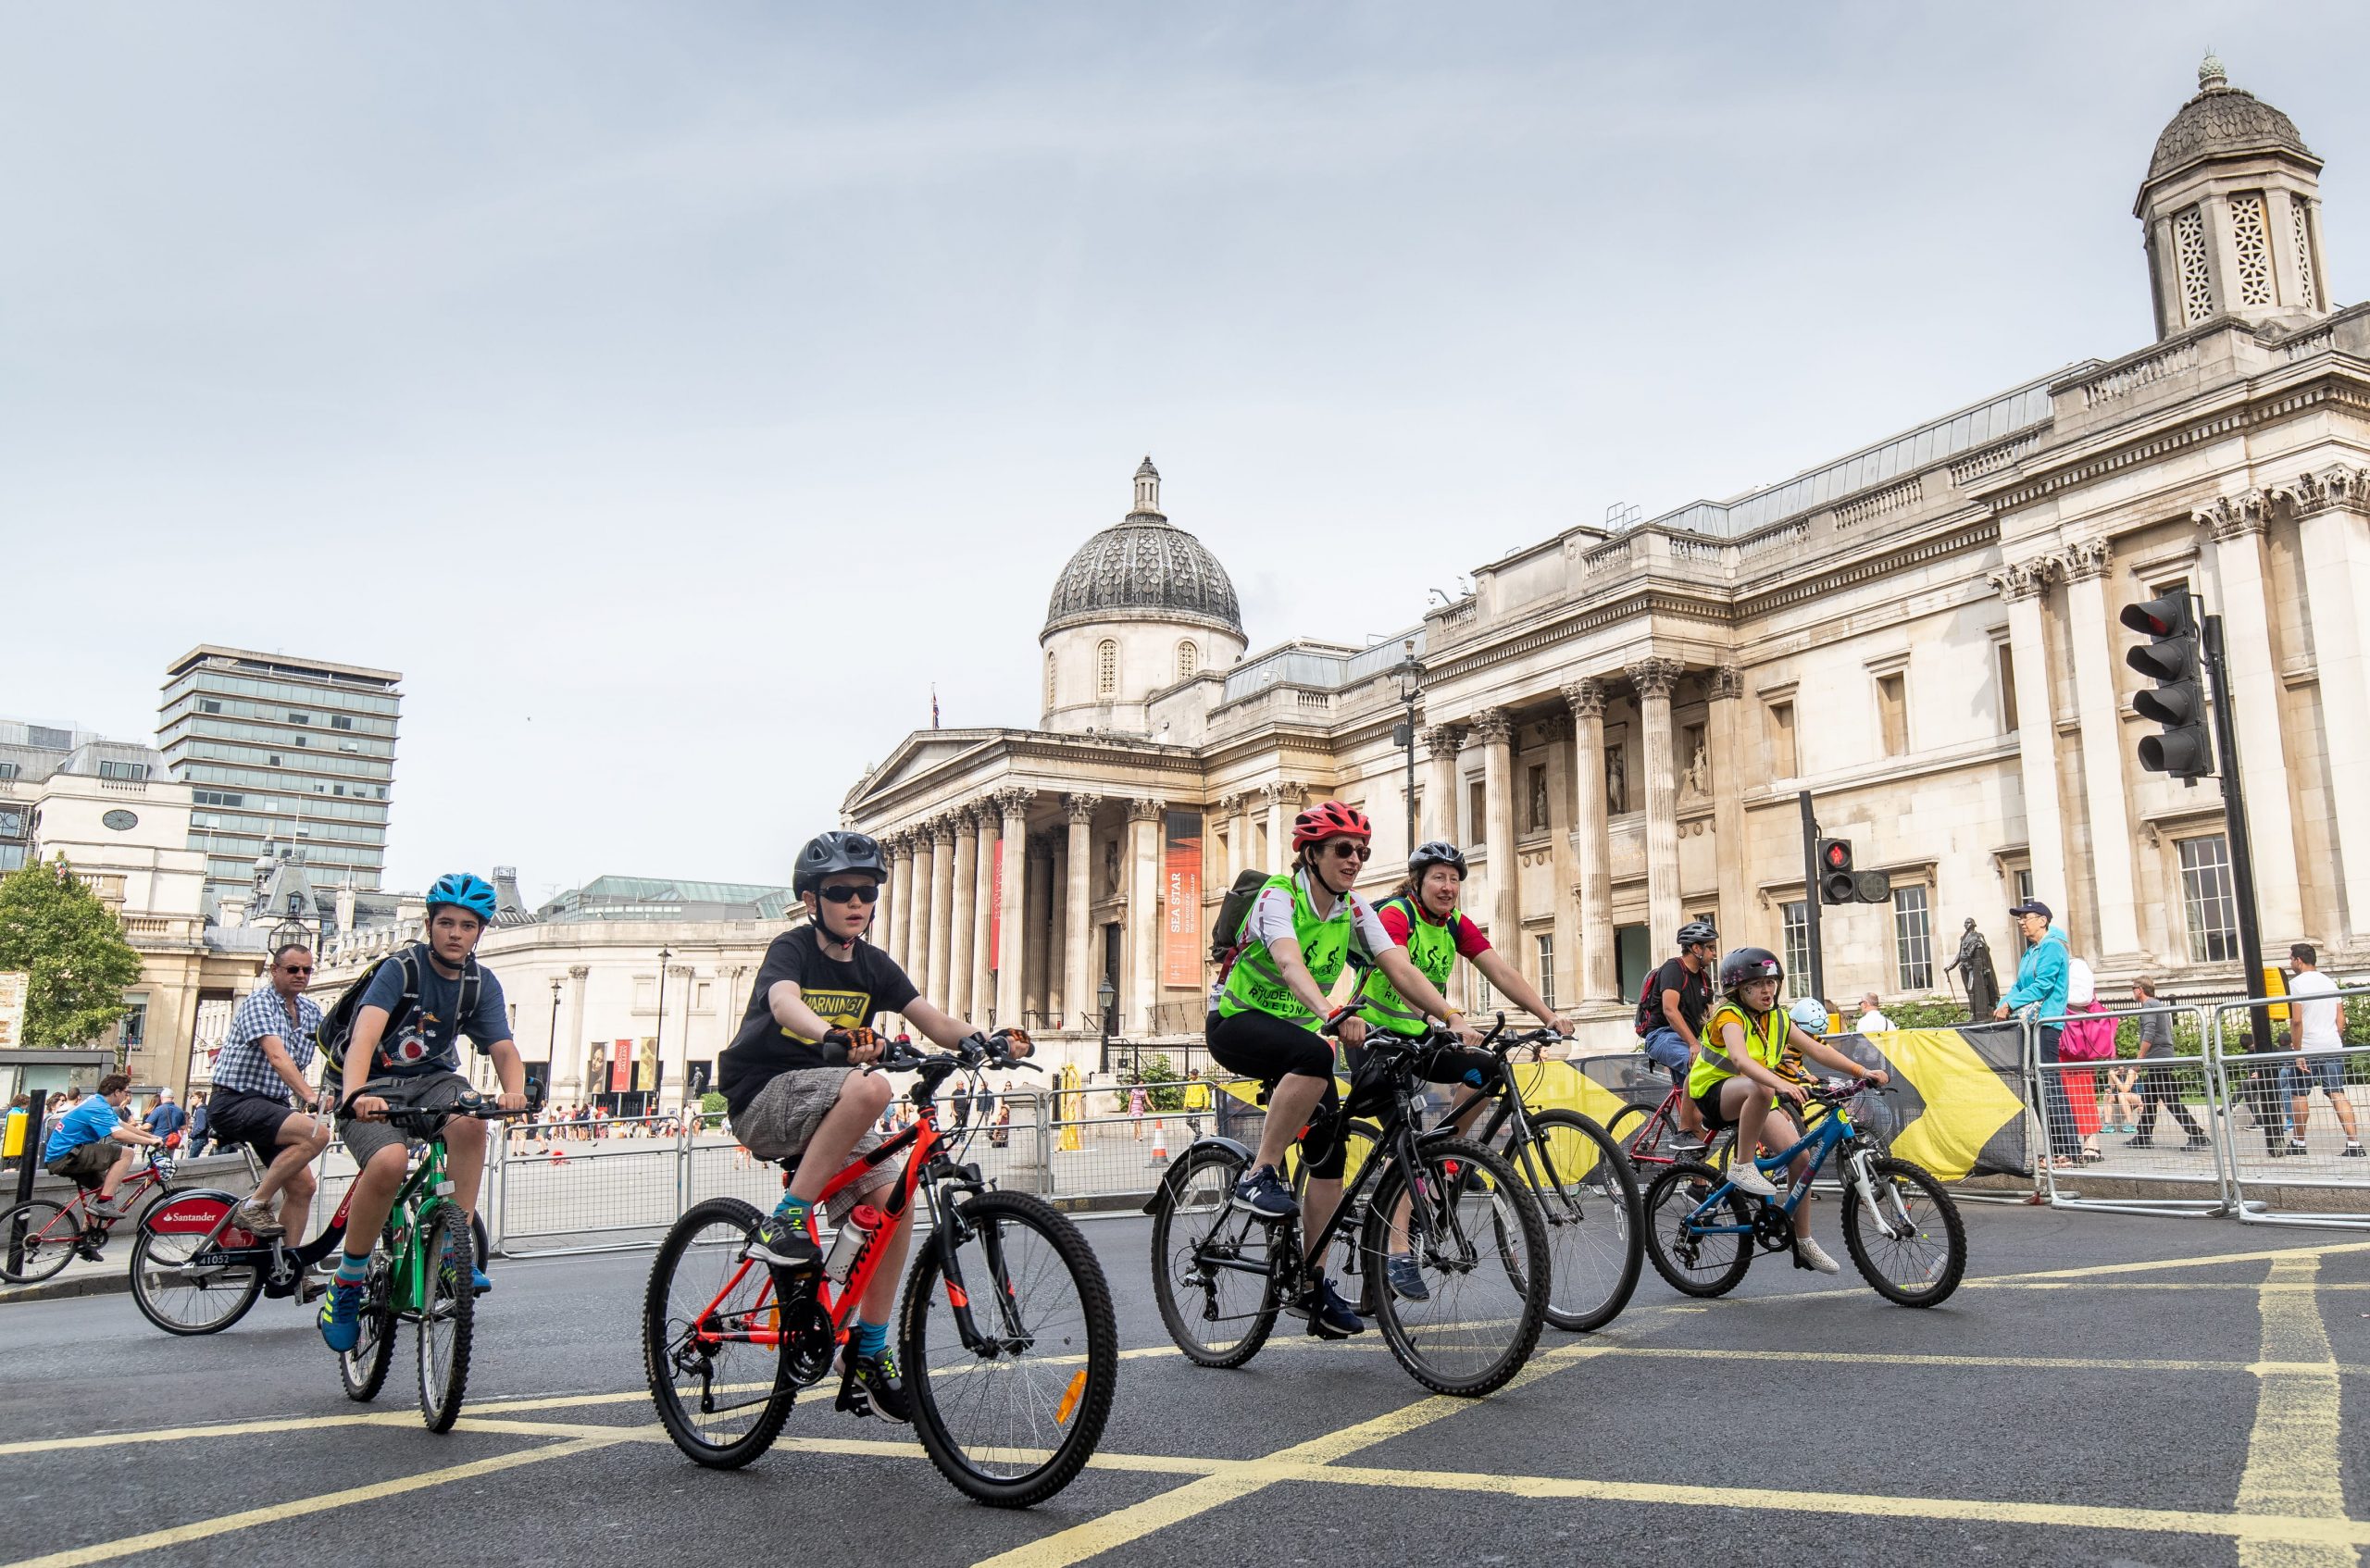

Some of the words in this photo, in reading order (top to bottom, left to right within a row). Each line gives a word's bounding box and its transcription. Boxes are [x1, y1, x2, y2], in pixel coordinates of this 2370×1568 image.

[1171, 872, 1180, 905] STAR
[1171, 908, 1180, 933] SEA
[172, 1212, 217, 1222] Santander
[199, 1254, 230, 1265] 41052
